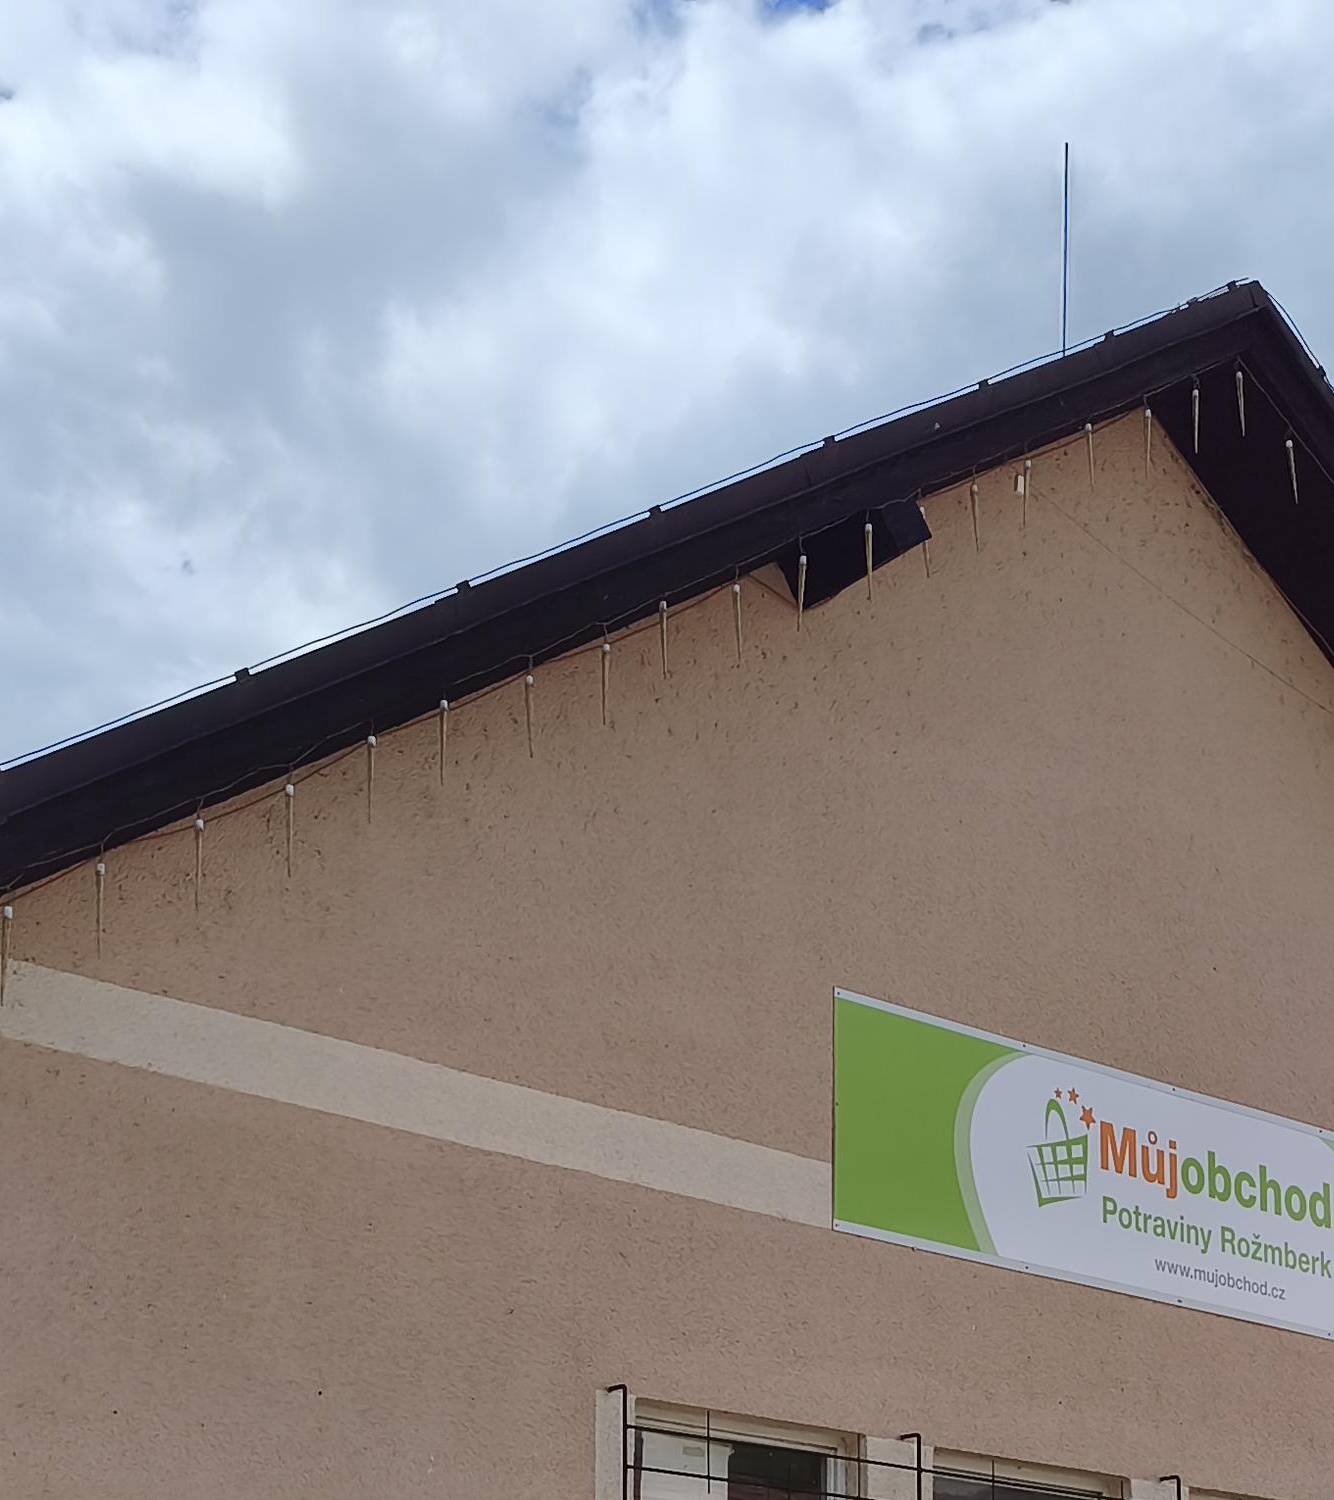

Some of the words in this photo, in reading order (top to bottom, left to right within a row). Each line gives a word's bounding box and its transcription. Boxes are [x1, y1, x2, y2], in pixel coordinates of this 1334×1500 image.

[1099, 1120, 1332, 1229] Můjobchod
[1102, 1195, 1212, 1255] Potraviny
[1221, 1224, 1333, 1279] Rožmberk
[1154, 1257, 1286, 1301] www.mujobchod.cz
